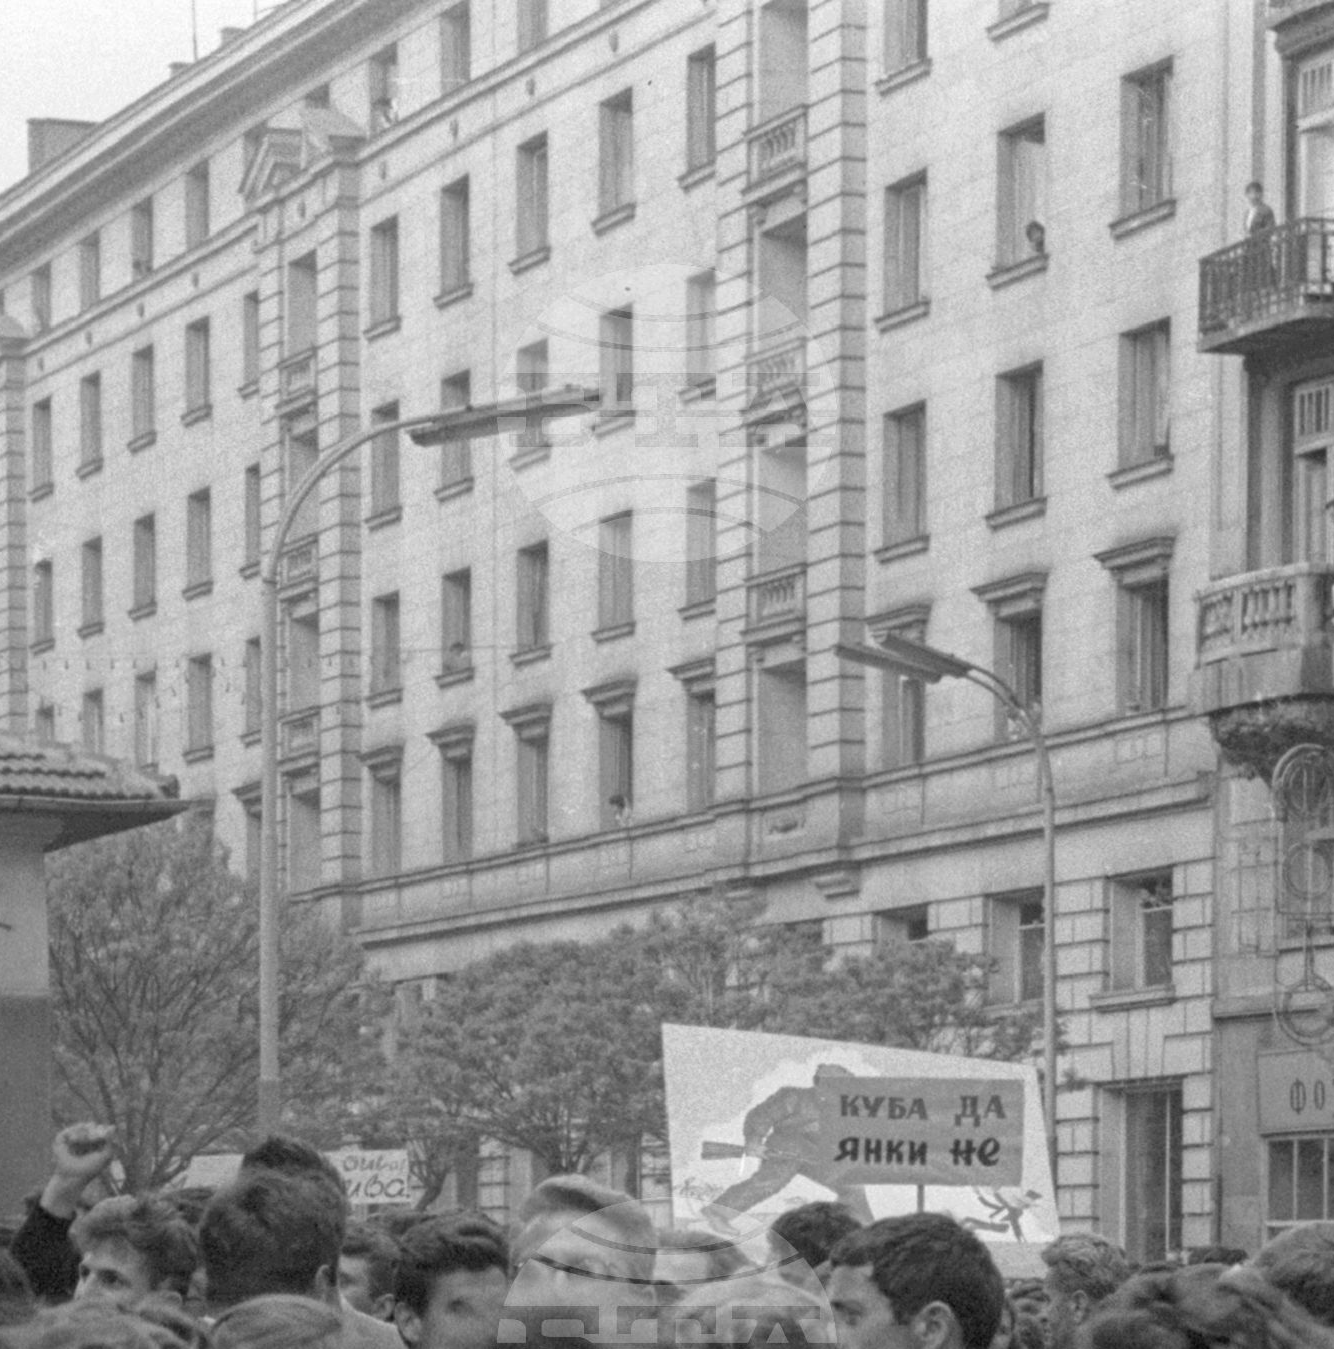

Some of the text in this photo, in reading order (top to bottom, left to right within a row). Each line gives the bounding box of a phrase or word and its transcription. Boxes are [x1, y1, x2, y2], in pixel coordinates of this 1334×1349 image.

[839, 1093, 1006, 1127] КУБА ДА
[833, 1136, 928, 1166] ЯНКИ
